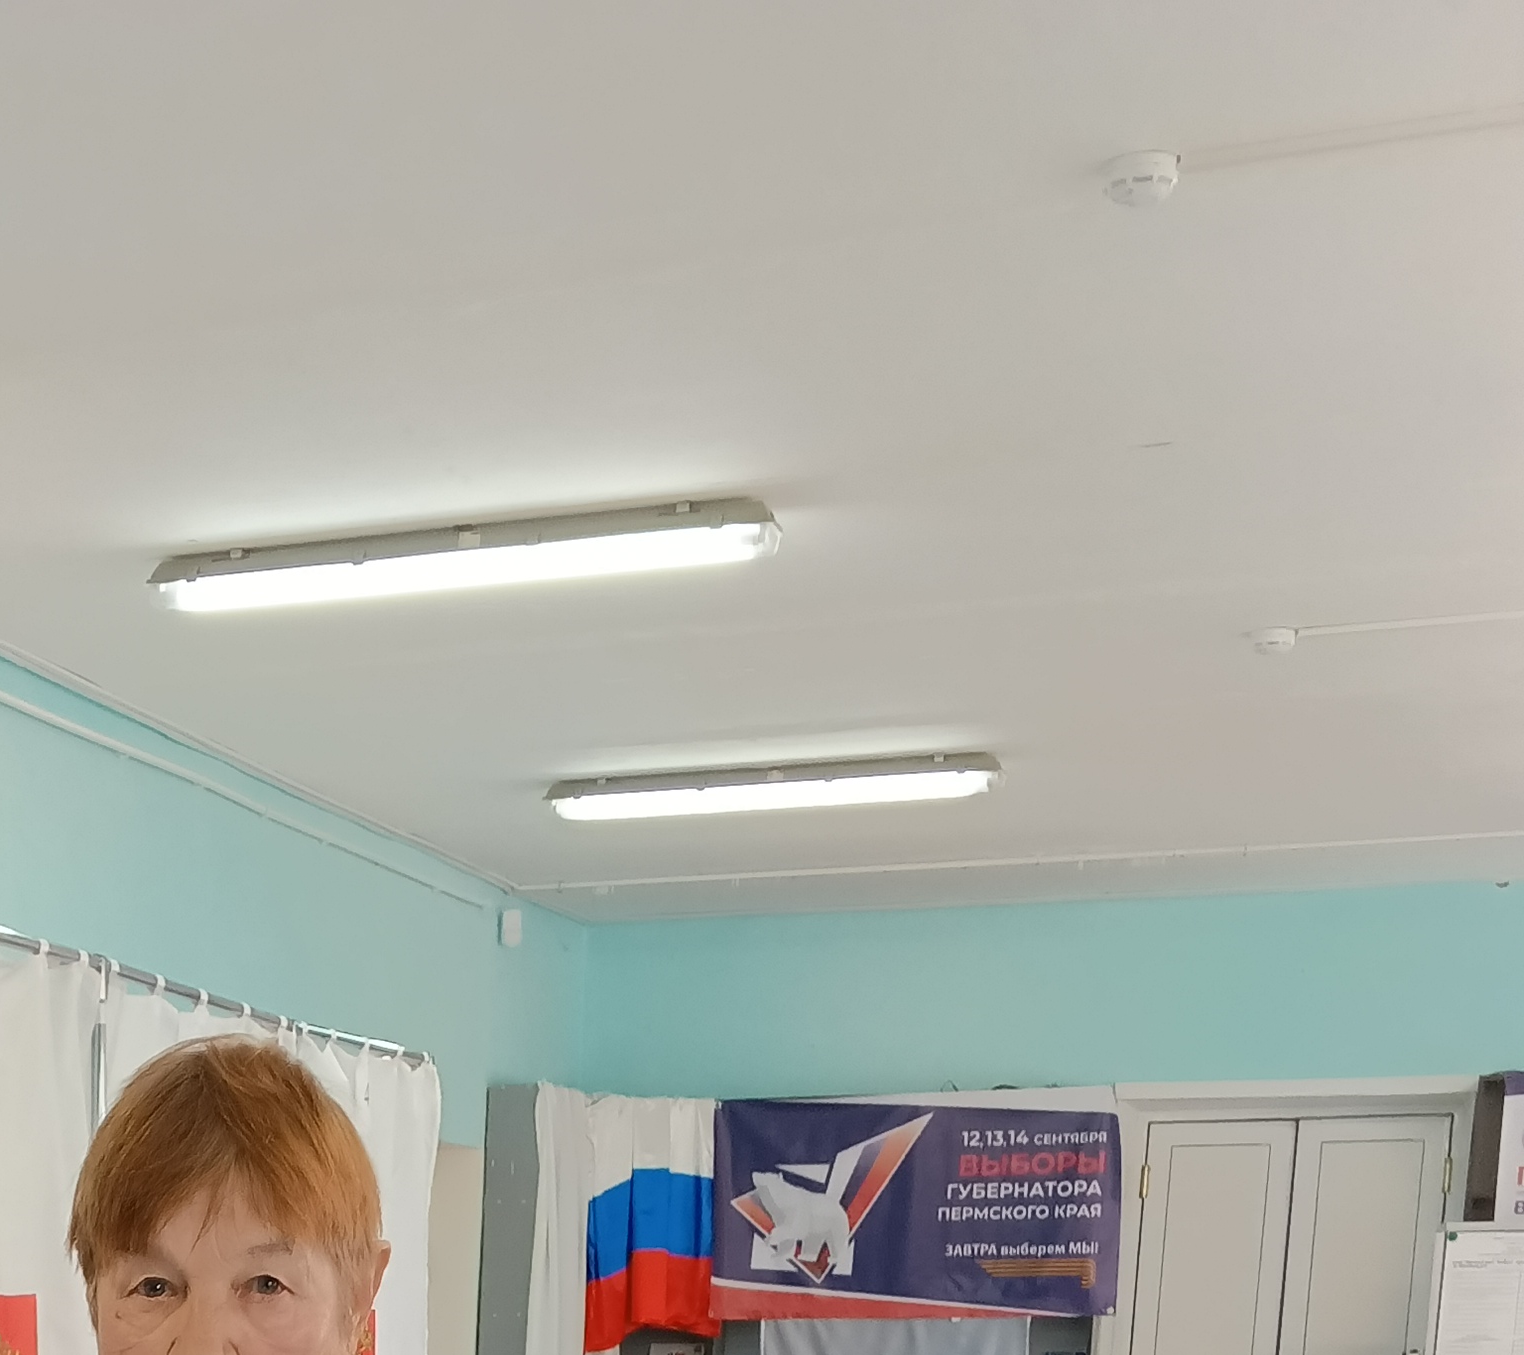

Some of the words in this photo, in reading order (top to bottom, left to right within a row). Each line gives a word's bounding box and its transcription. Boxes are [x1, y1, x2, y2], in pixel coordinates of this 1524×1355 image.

[1034, 1131, 1107, 1146] СЕНТЯБРЯ
[959, 1151, 1107, 1177] ВЫБОРЫ
[947, 1180, 1102, 1200] ГУБЕРНАТОРА
[937, 1205, 1049, 1222] ПЕРМСКОГО
[1054, 1203, 1102, 1219] КРАЯ
[945, 1242, 997, 1257] ЗАВТРА
[1001, 1241, 1066, 1257] выберем
